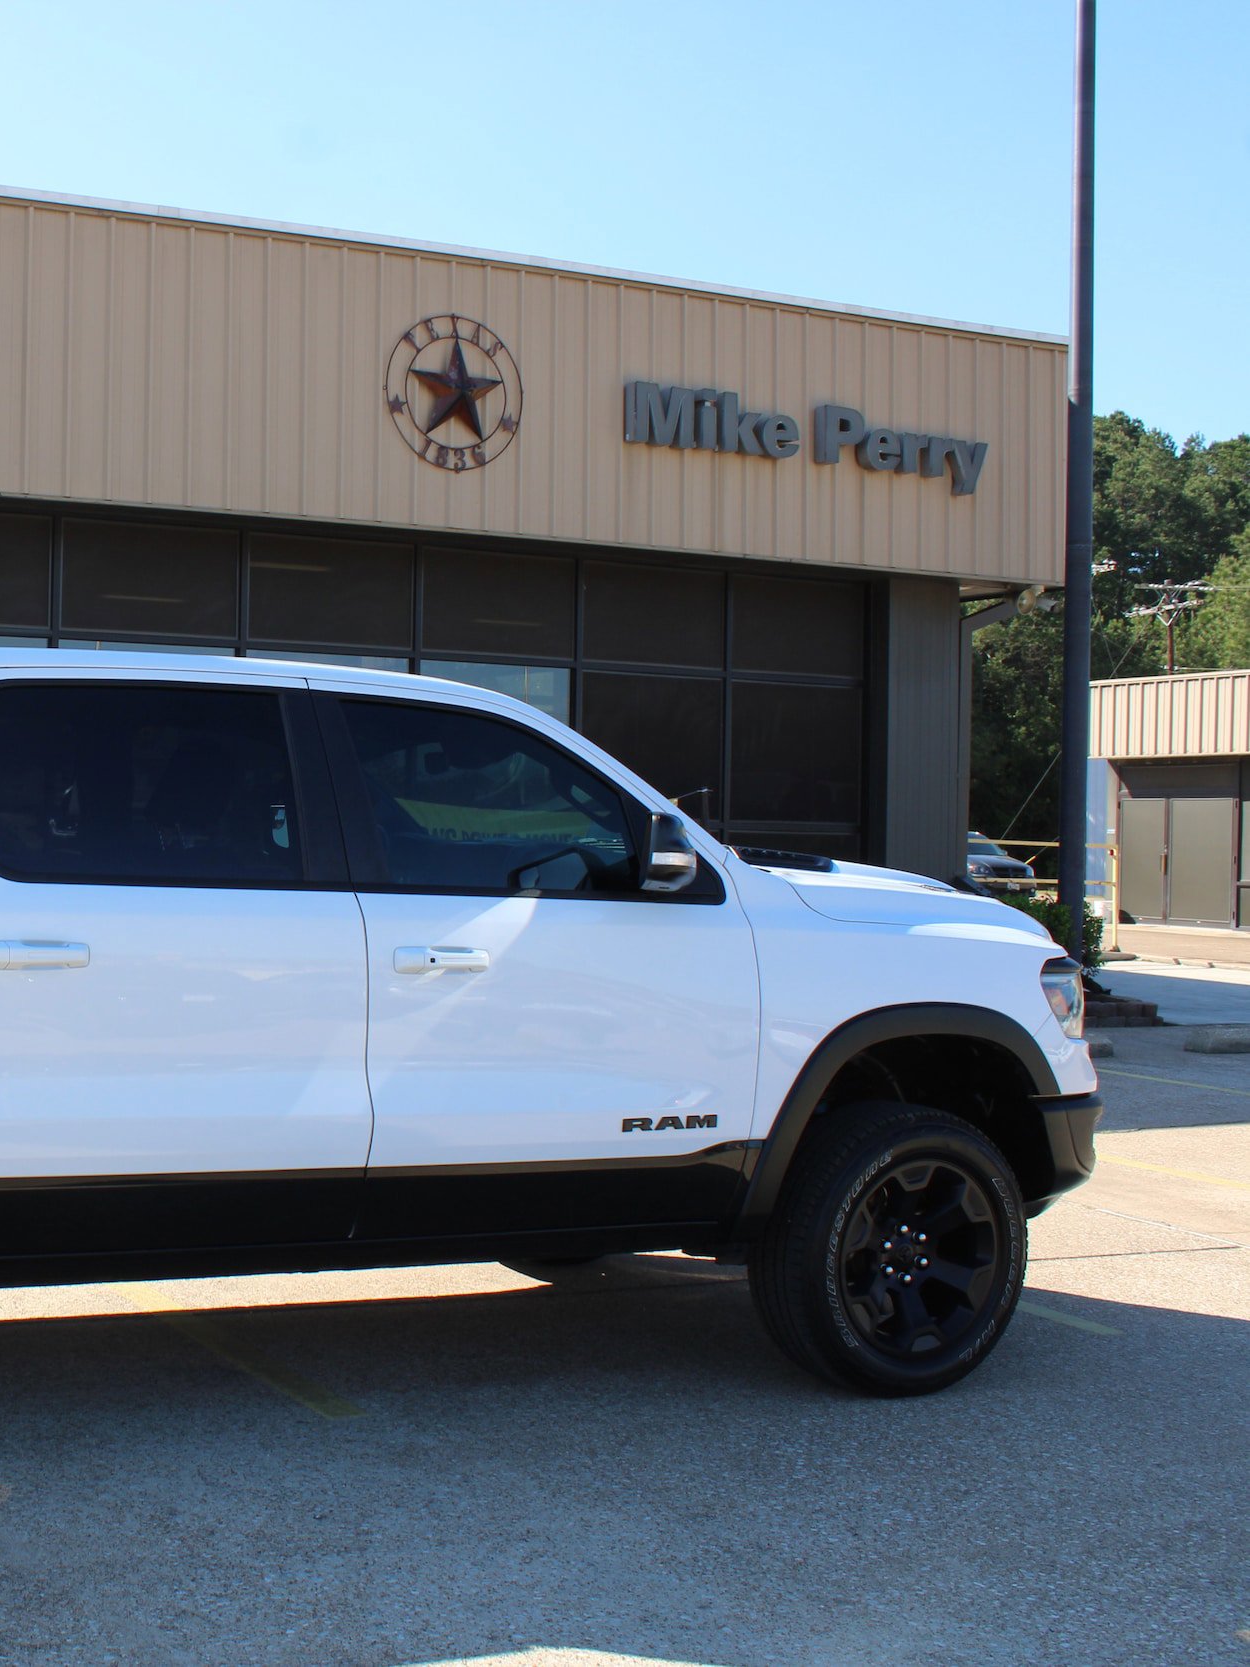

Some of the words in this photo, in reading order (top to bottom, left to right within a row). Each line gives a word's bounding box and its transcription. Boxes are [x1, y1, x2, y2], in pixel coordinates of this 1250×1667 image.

[403, 315, 505, 358] TEXAS
[418, 437, 487, 471] 1836
[623, 380, 800, 459] Mike
[813, 403, 990, 497] Perry
[621, 1114, 718, 1133] RAM
